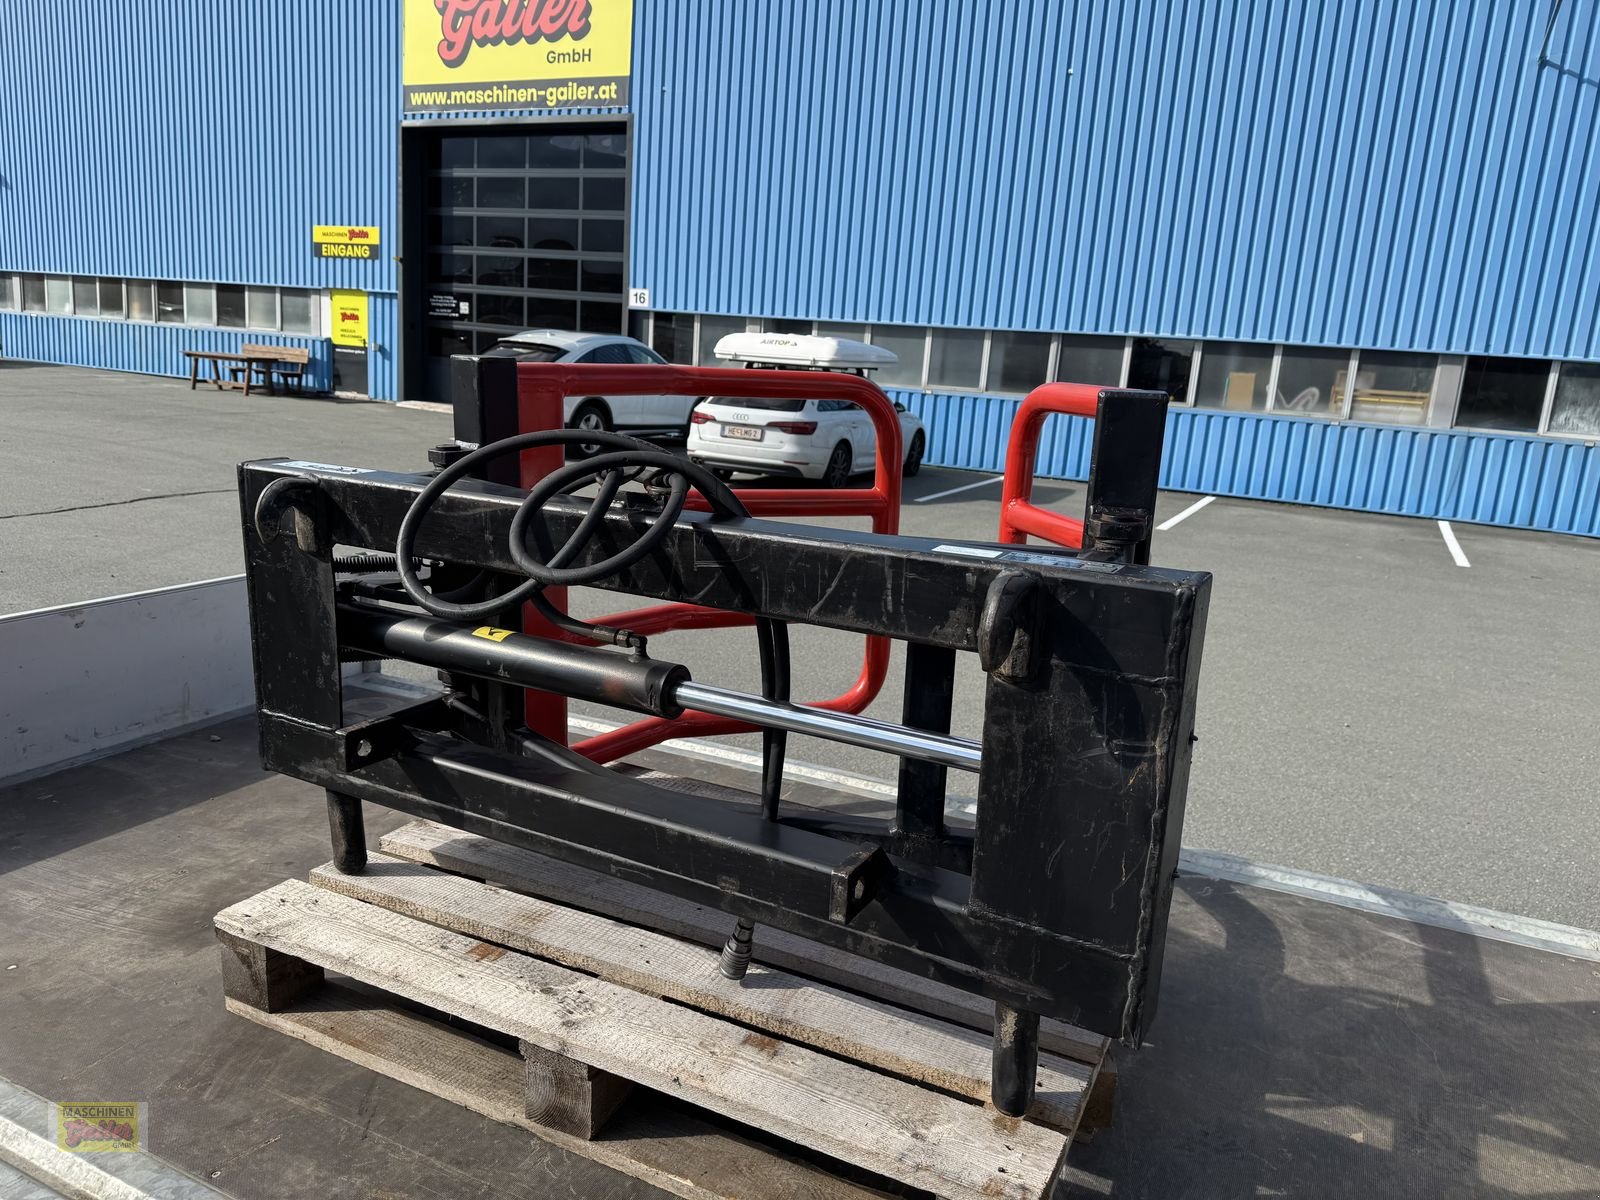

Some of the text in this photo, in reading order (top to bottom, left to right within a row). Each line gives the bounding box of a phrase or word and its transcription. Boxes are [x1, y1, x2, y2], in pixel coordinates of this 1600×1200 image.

[546, 48, 592, 64] GmbH
[410, 82, 617, 106] www.maschinen-gailer.at
[322, 244, 370, 257] EINGANG
[634, 288, 646, 304] 16
[760, 338, 790, 346] AIRTOP
